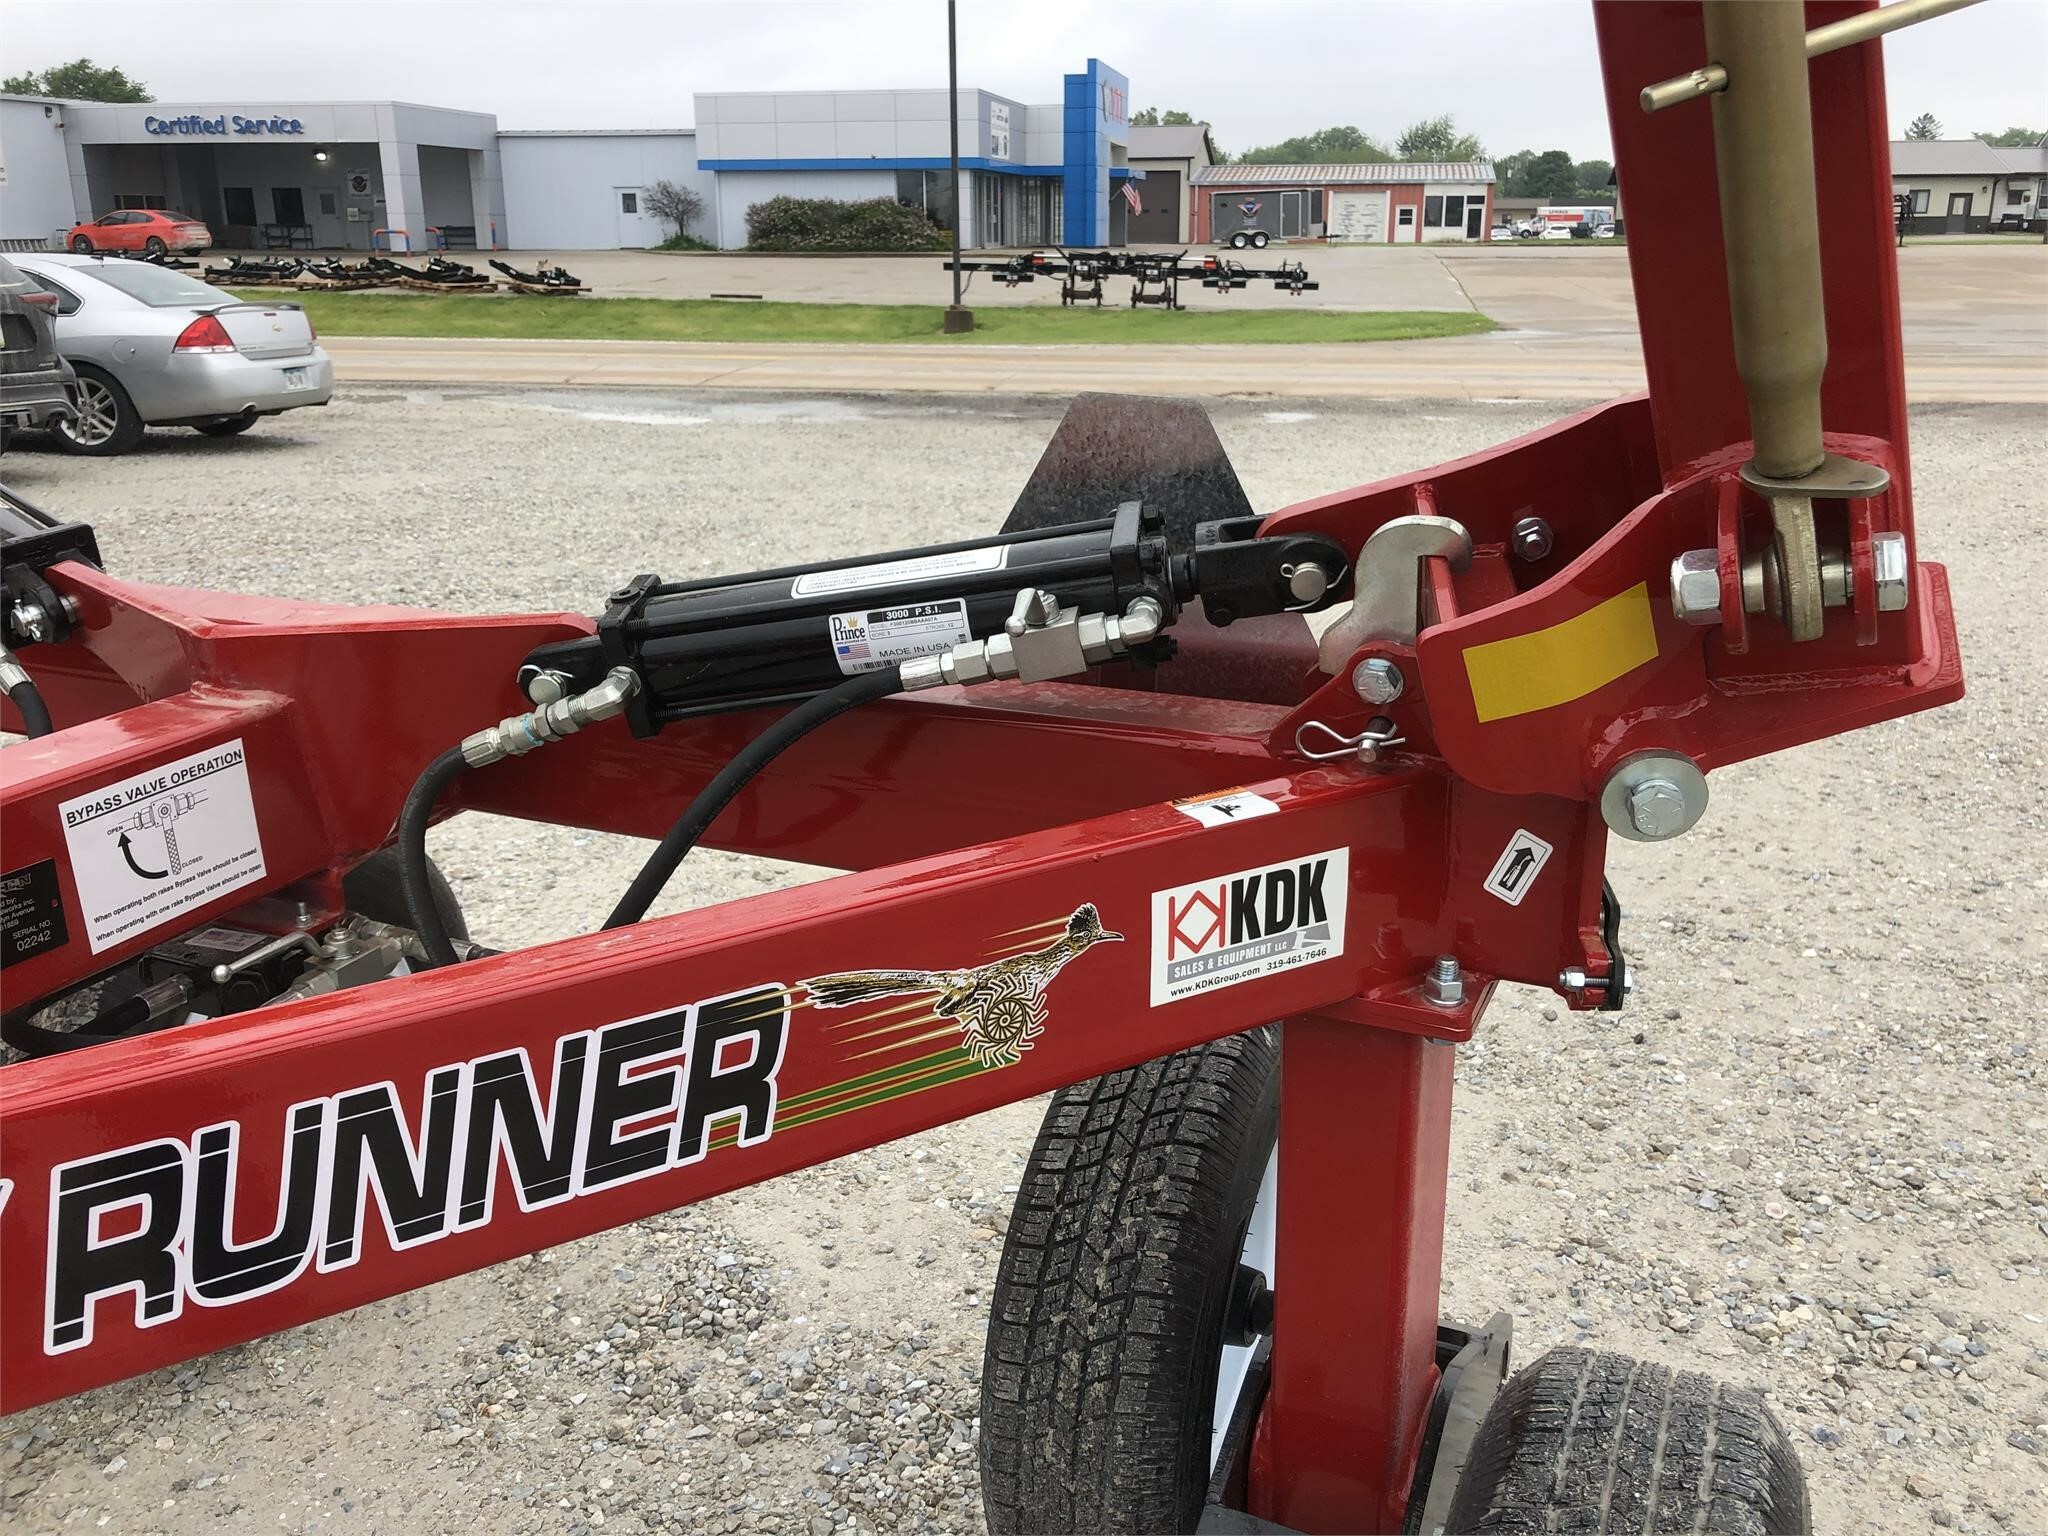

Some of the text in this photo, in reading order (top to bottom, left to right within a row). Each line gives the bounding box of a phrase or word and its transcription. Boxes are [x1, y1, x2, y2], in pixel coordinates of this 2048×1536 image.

[144, 114, 304, 136] Certified Service
[886, 605, 942, 620] 3000 P.S.I.
[831, 616, 866, 641] Prince
[879, 647, 911, 658] MADE
[927, 642, 951, 651] USA
[66, 749, 243, 825] BYPASS VALVE OPERATION
[106, 825, 124, 836] OPEN
[182, 855, 204, 869] CLOSED
[93, 847, 258, 924] When operating both rakes Bypass Valve should be closed
[11, 906, 35, 919] Avenue
[95, 863, 262, 942] When operating with one rake Bypass Valve should be open
[1230, 858, 1328, 945] KDK
[12, 925, 38, 939] SERIAL
[17, 930, 51, 951] 02242
[1174, 941, 1287, 979] SALES & EQUIPMENT LLC
[1170, 947, 1327, 997] www.KDKGroup.com 319-461-7646
[44, 981, 792, 1357] RUNNER
